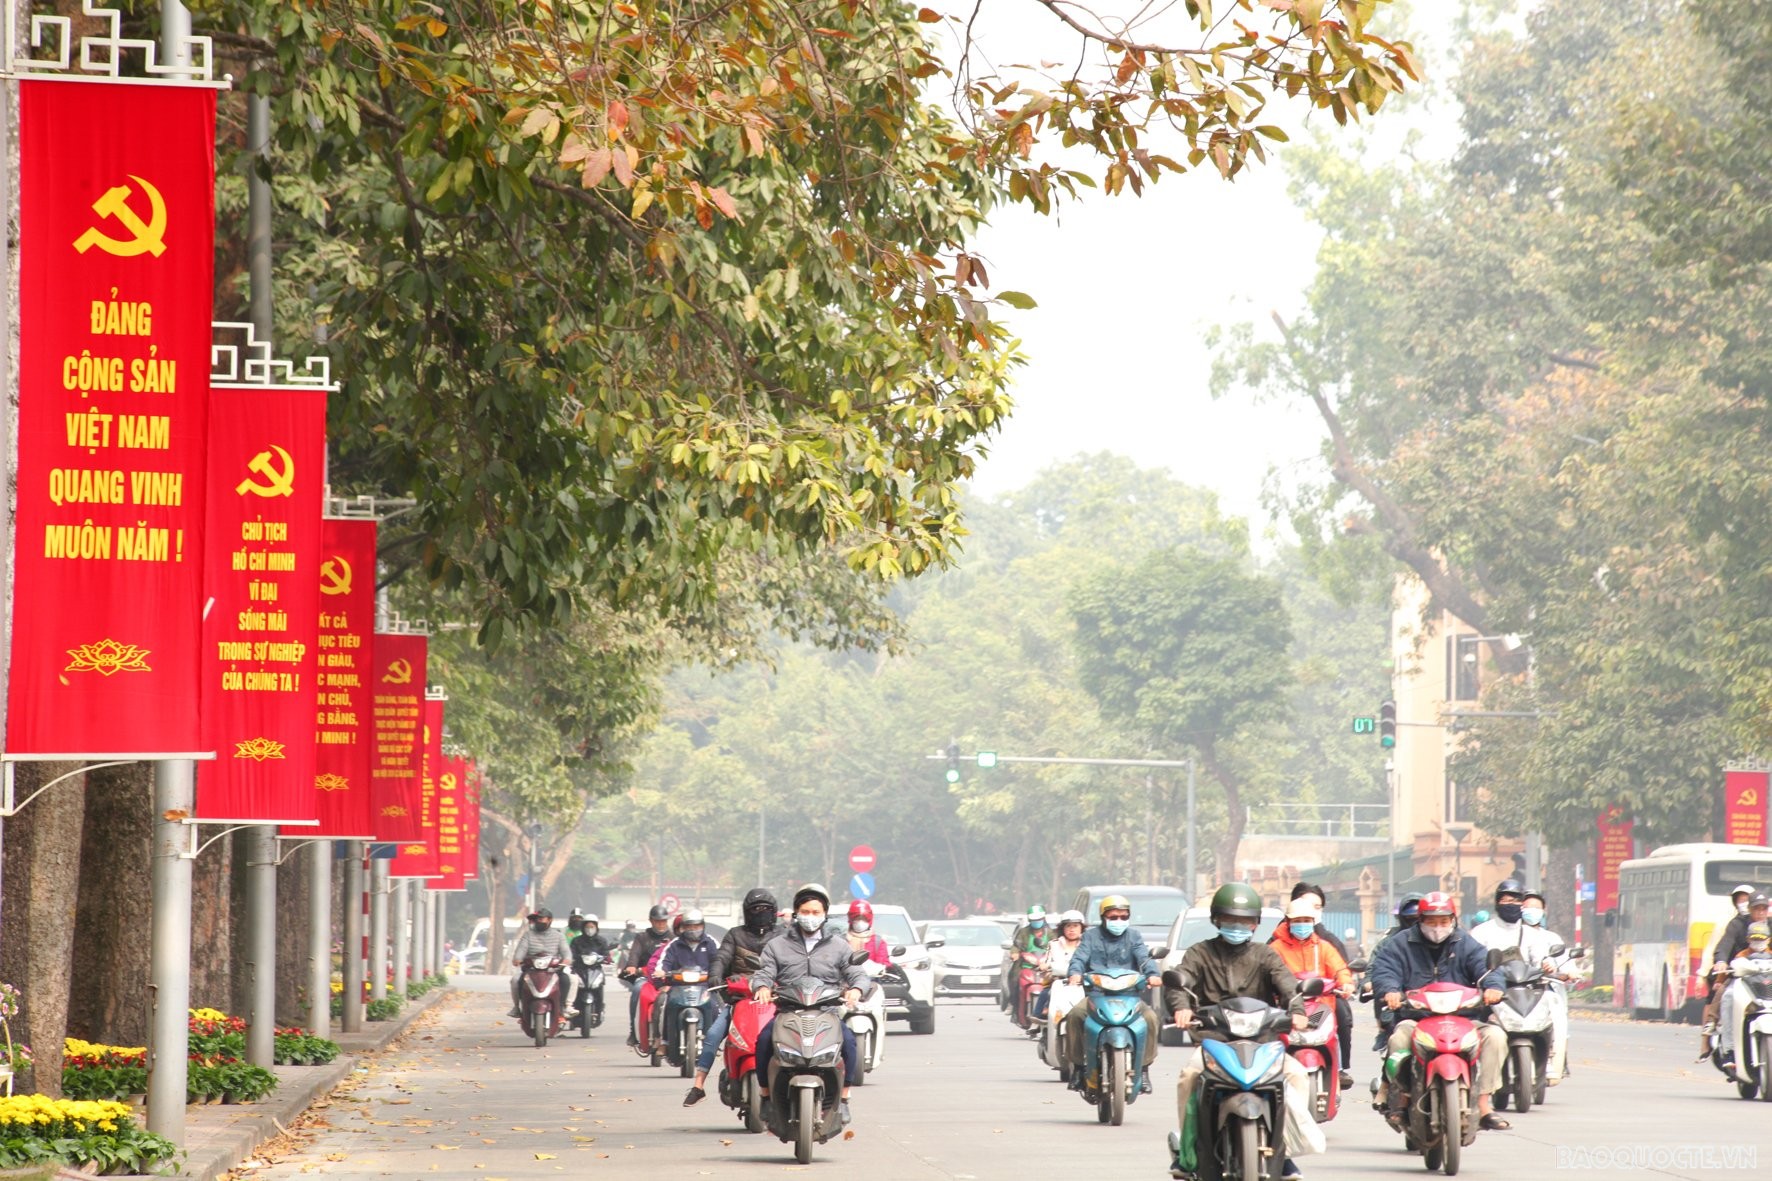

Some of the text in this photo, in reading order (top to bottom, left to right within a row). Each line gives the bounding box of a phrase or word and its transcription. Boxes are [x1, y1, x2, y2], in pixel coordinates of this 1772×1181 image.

[91, 287, 151, 336] ĐẢNG
[63, 345, 176, 398] CỘNG SẢN
[66, 407, 170, 454] VIỆT NAM
[50, 468, 182, 506] QUANG VINH
[45, 519, 183, 562] MUÔN NĂM !
[242, 515, 287, 544] CHỦ TỊCH
[249, 549, 266, 570] CHÍ
[268, 553, 295, 571] MINH
[261, 582, 277, 605] ĐẠI
[239, 607, 287, 631] SỐNG MÃI
[334, 612, 347, 628] CẢ
[218, 642, 252, 660] TRONG
[269, 640, 306, 666] NGHIỆP
[319, 634, 360, 649] ỤC TIÊU
[327, 652, 355, 668] GIÀU,
[222, 664, 243, 690] CỦA
[245, 669, 278, 691] CHÚNG
[280, 673, 292, 691] TA
[327, 674, 361, 689] MẠNH,
[328, 688, 352, 707] CHỦ,
[328, 708, 358, 725] BẰNG,
[322, 732, 349, 744] MINH
